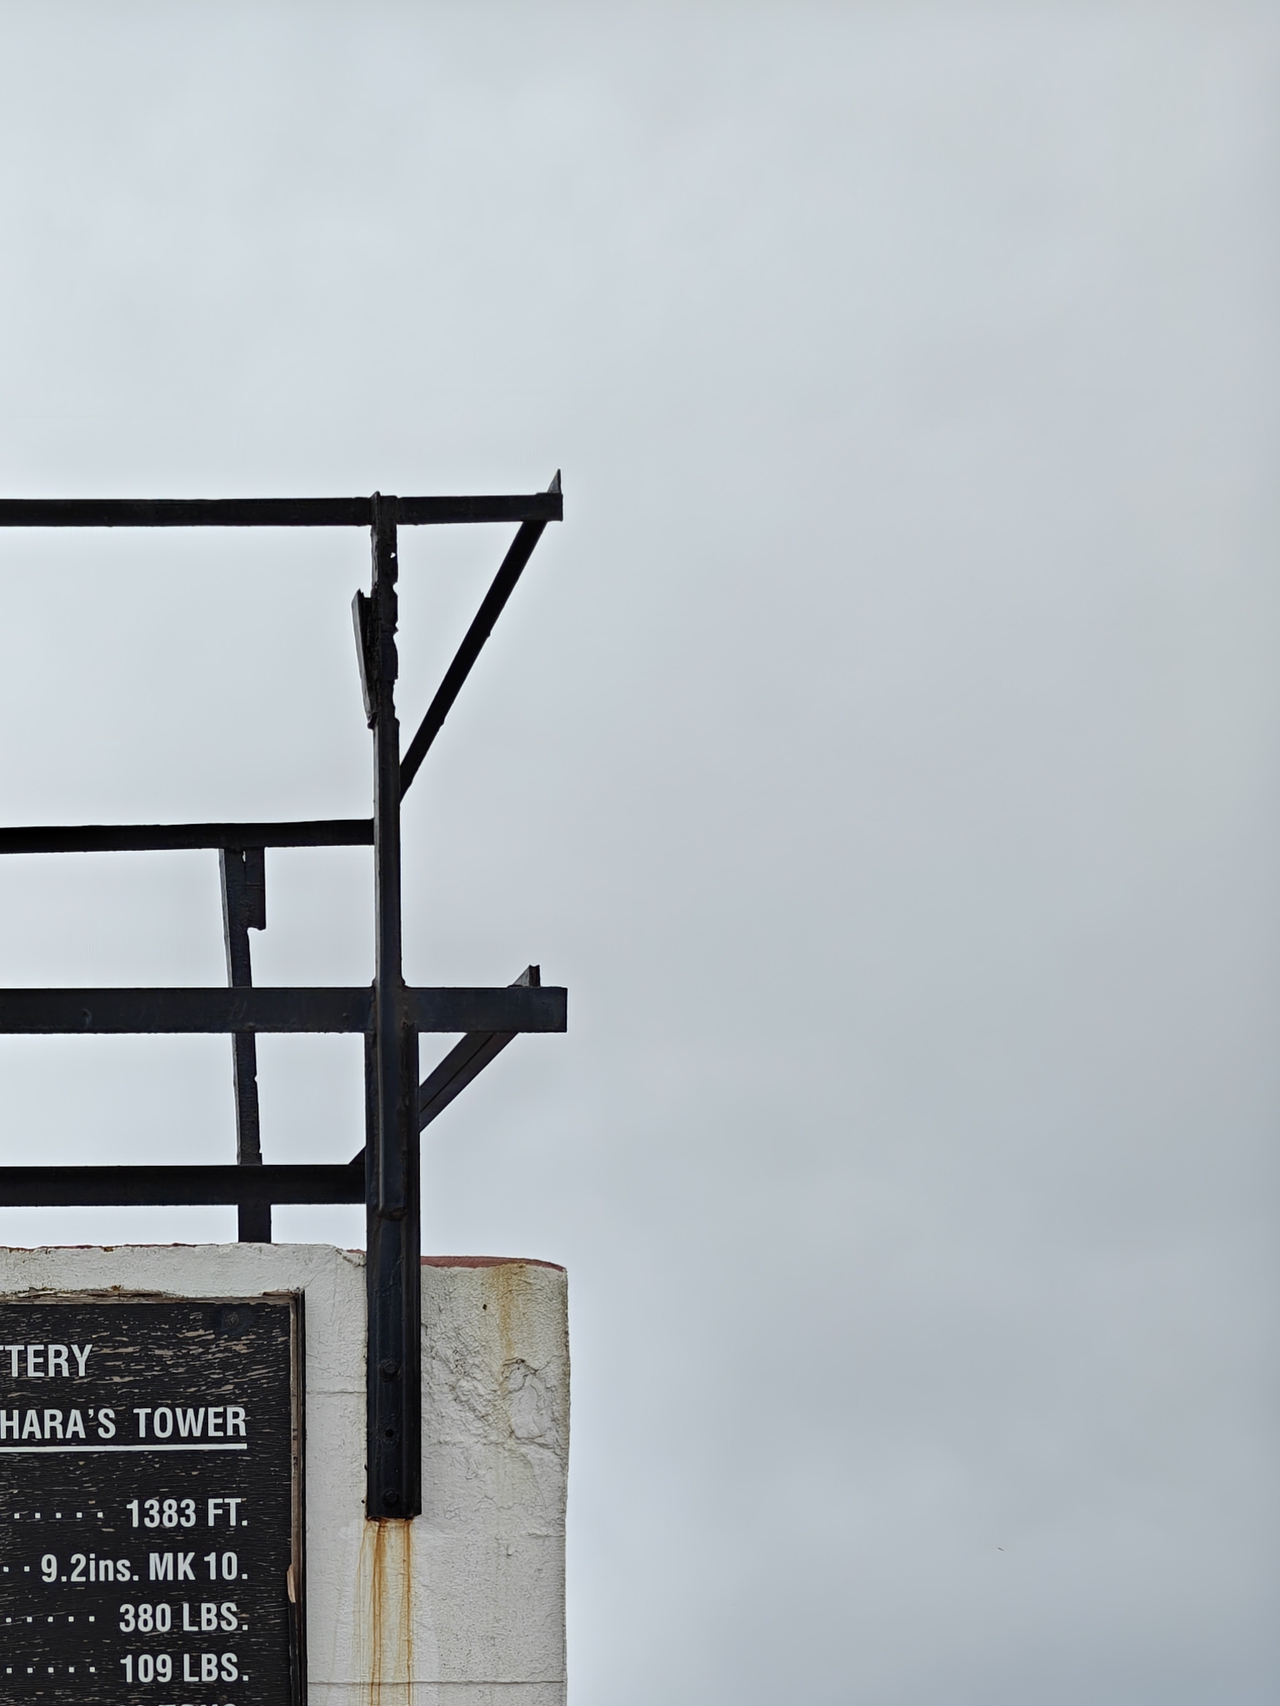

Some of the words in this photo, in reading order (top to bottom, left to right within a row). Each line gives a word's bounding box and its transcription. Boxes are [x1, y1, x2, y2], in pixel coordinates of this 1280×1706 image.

[133, 1406, 247, 1438] TOWER
[126, 1498, 196, 1528] 1383
[208, 1497, 248, 1527] FT.
[41, 1553, 139, 1583] 9.2ins.
[149, 1552, 196, 1581] MK
[203, 1551, 248, 1581] 10.
[119, 1603, 171, 1633] 380
[182, 1602, 248, 1631] LBS.
[120, 1654, 172, 1683] 109
[183, 1652, 249, 1682] LBS.
